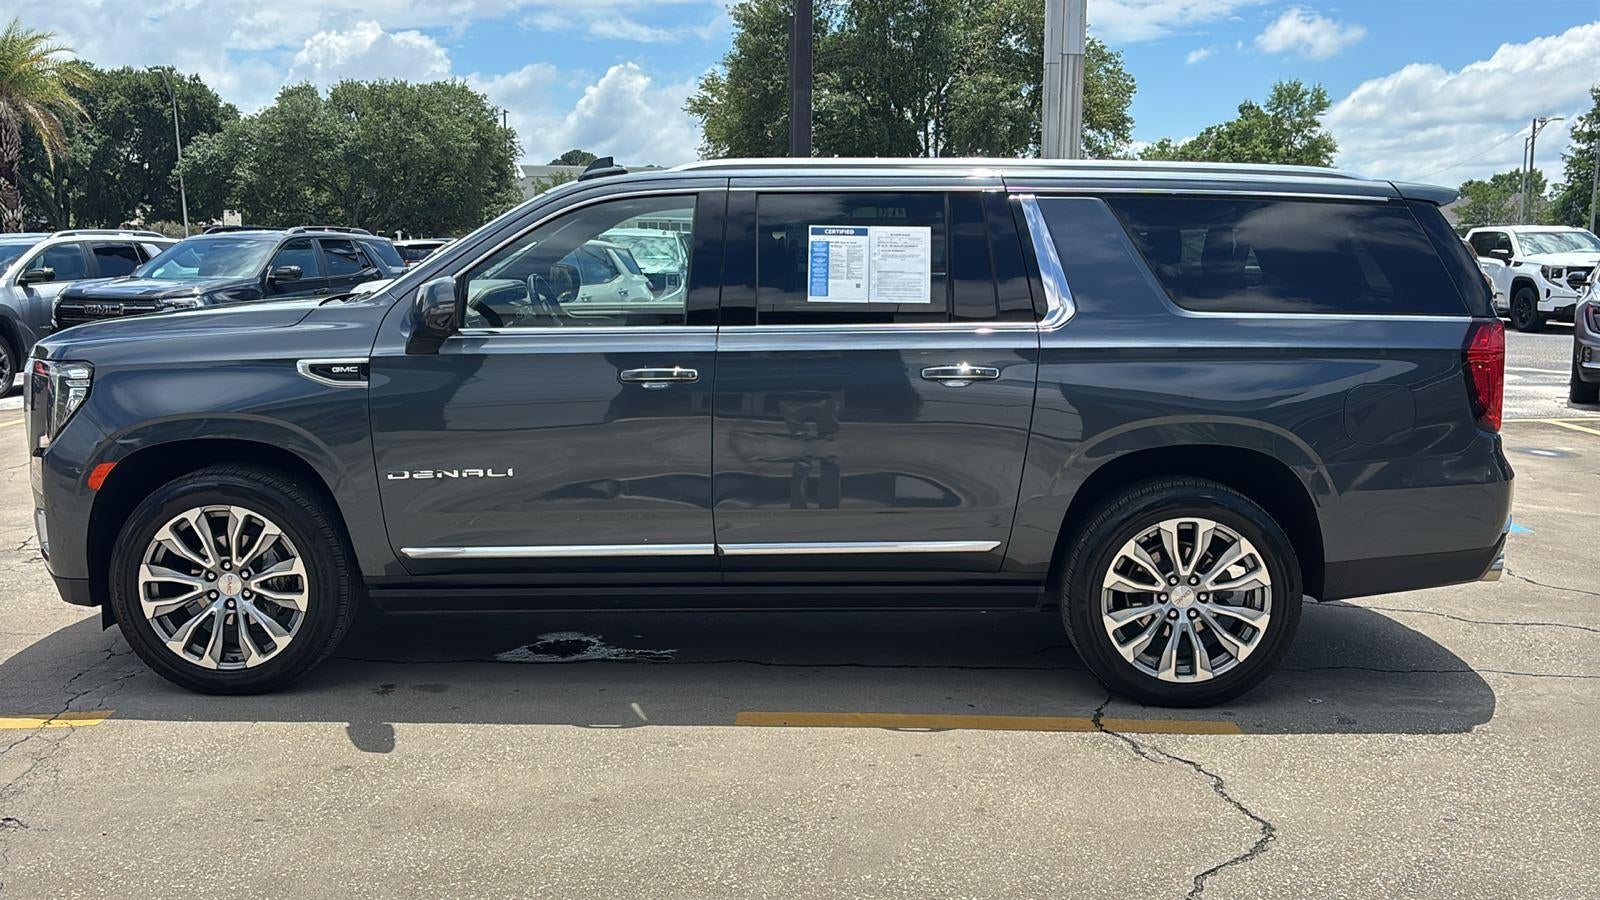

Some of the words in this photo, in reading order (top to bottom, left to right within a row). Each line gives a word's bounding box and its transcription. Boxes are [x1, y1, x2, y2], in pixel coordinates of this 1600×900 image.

[84, 304, 119, 314] GMC
[387, 467, 514, 480] DENALI
[1174, 589, 1192, 605] GMC
